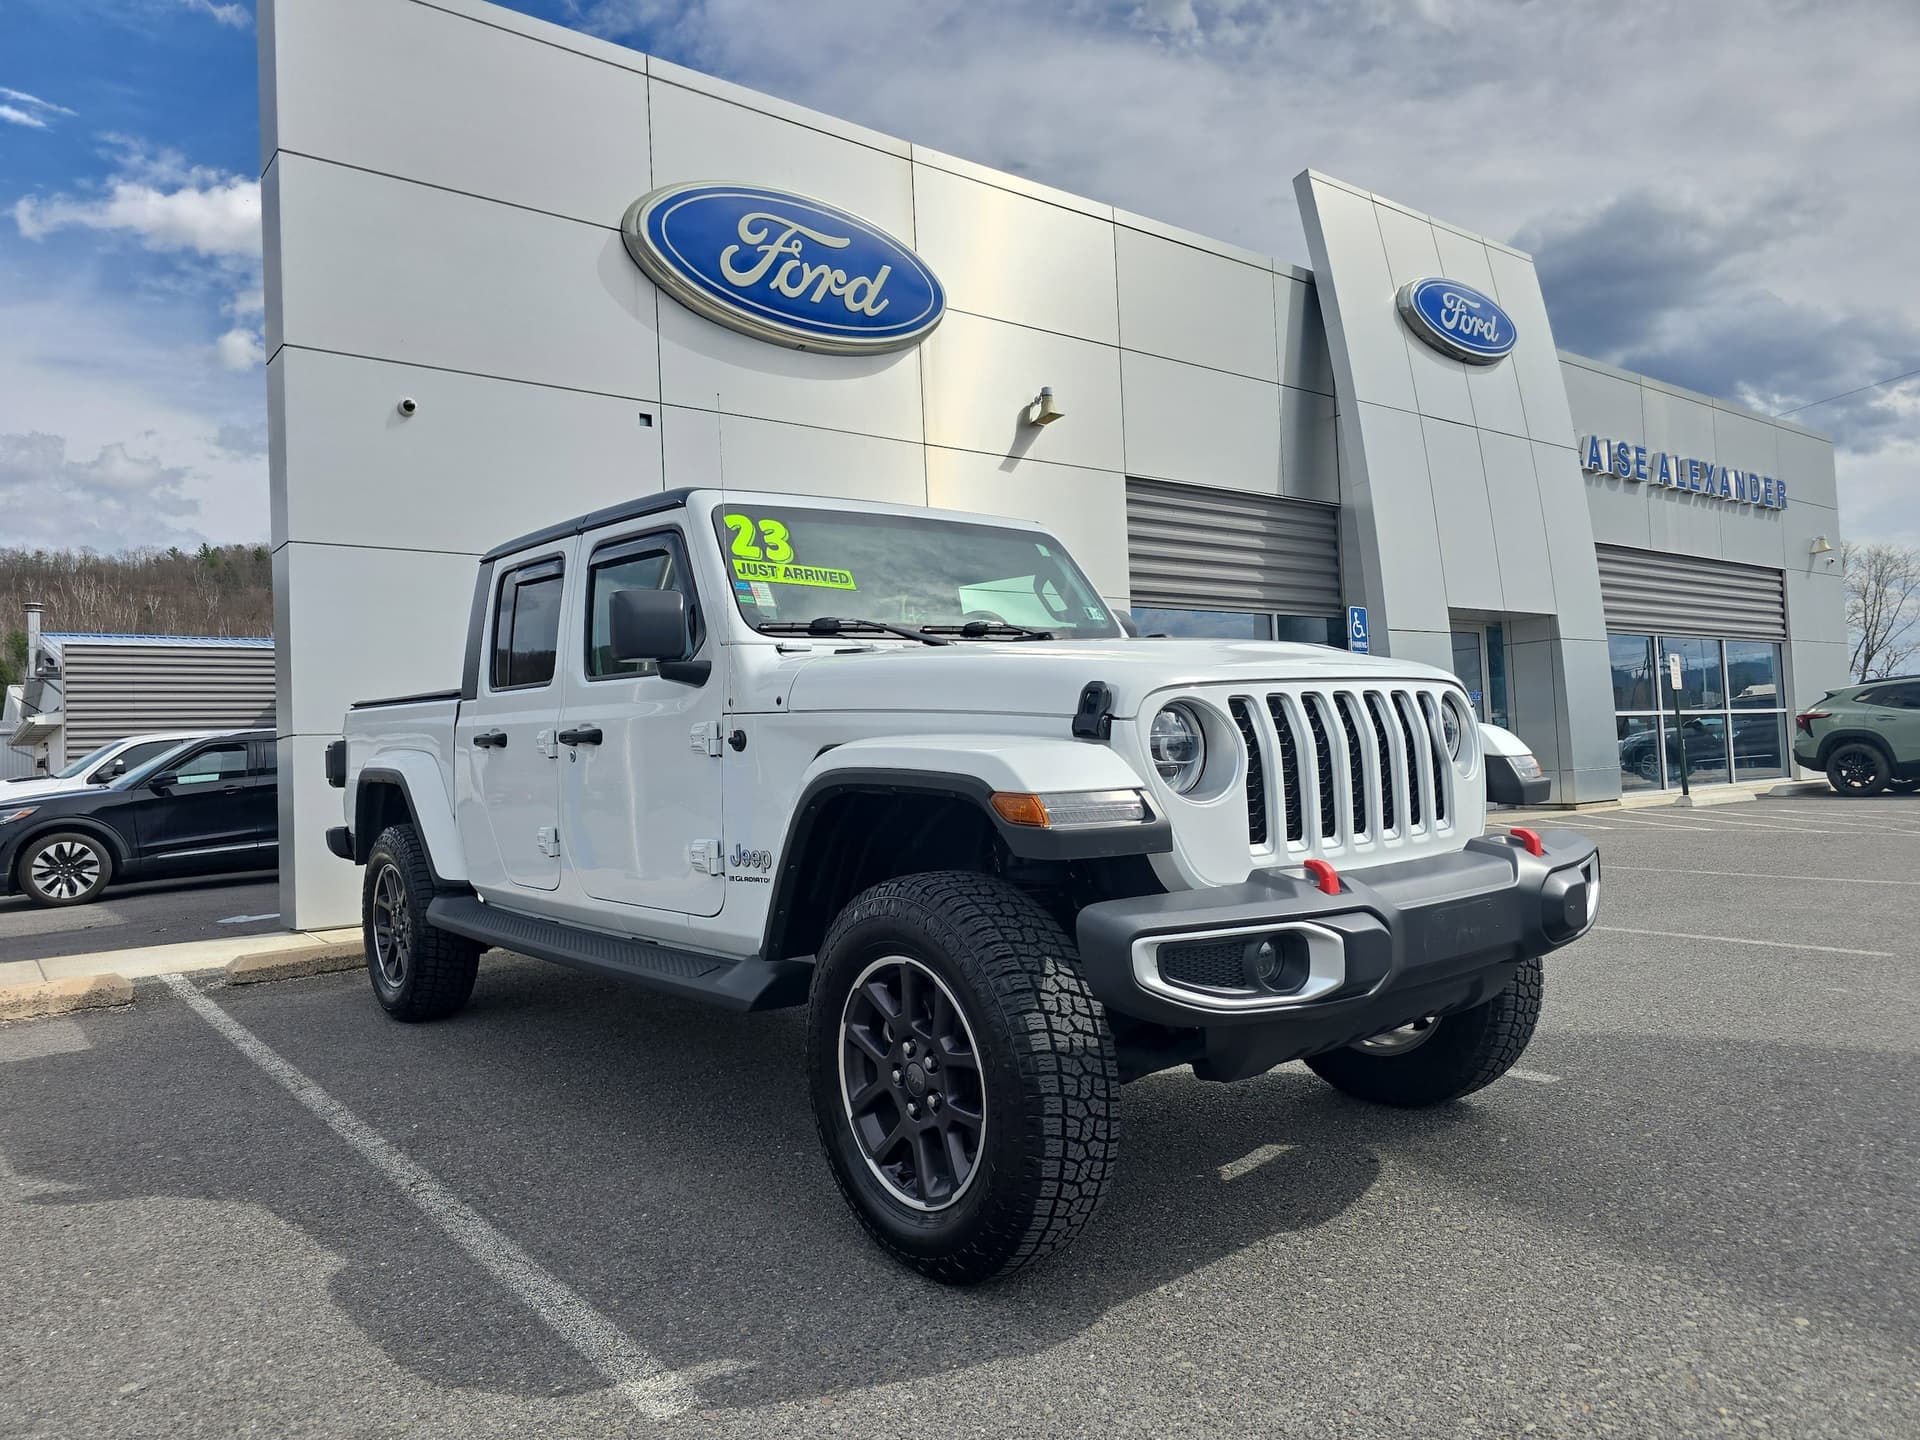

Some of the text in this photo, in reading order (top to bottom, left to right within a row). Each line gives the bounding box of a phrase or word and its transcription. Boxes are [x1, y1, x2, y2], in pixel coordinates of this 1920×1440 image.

[720, 212, 891, 317] Ford
[1441, 292, 1499, 342] Ford
[1580, 435, 1787, 509] AISE ALEXANDER
[723, 514, 794, 564] 23
[738, 562, 849, 584] JUST ARRIVED
[730, 843, 772, 874] Jeep
